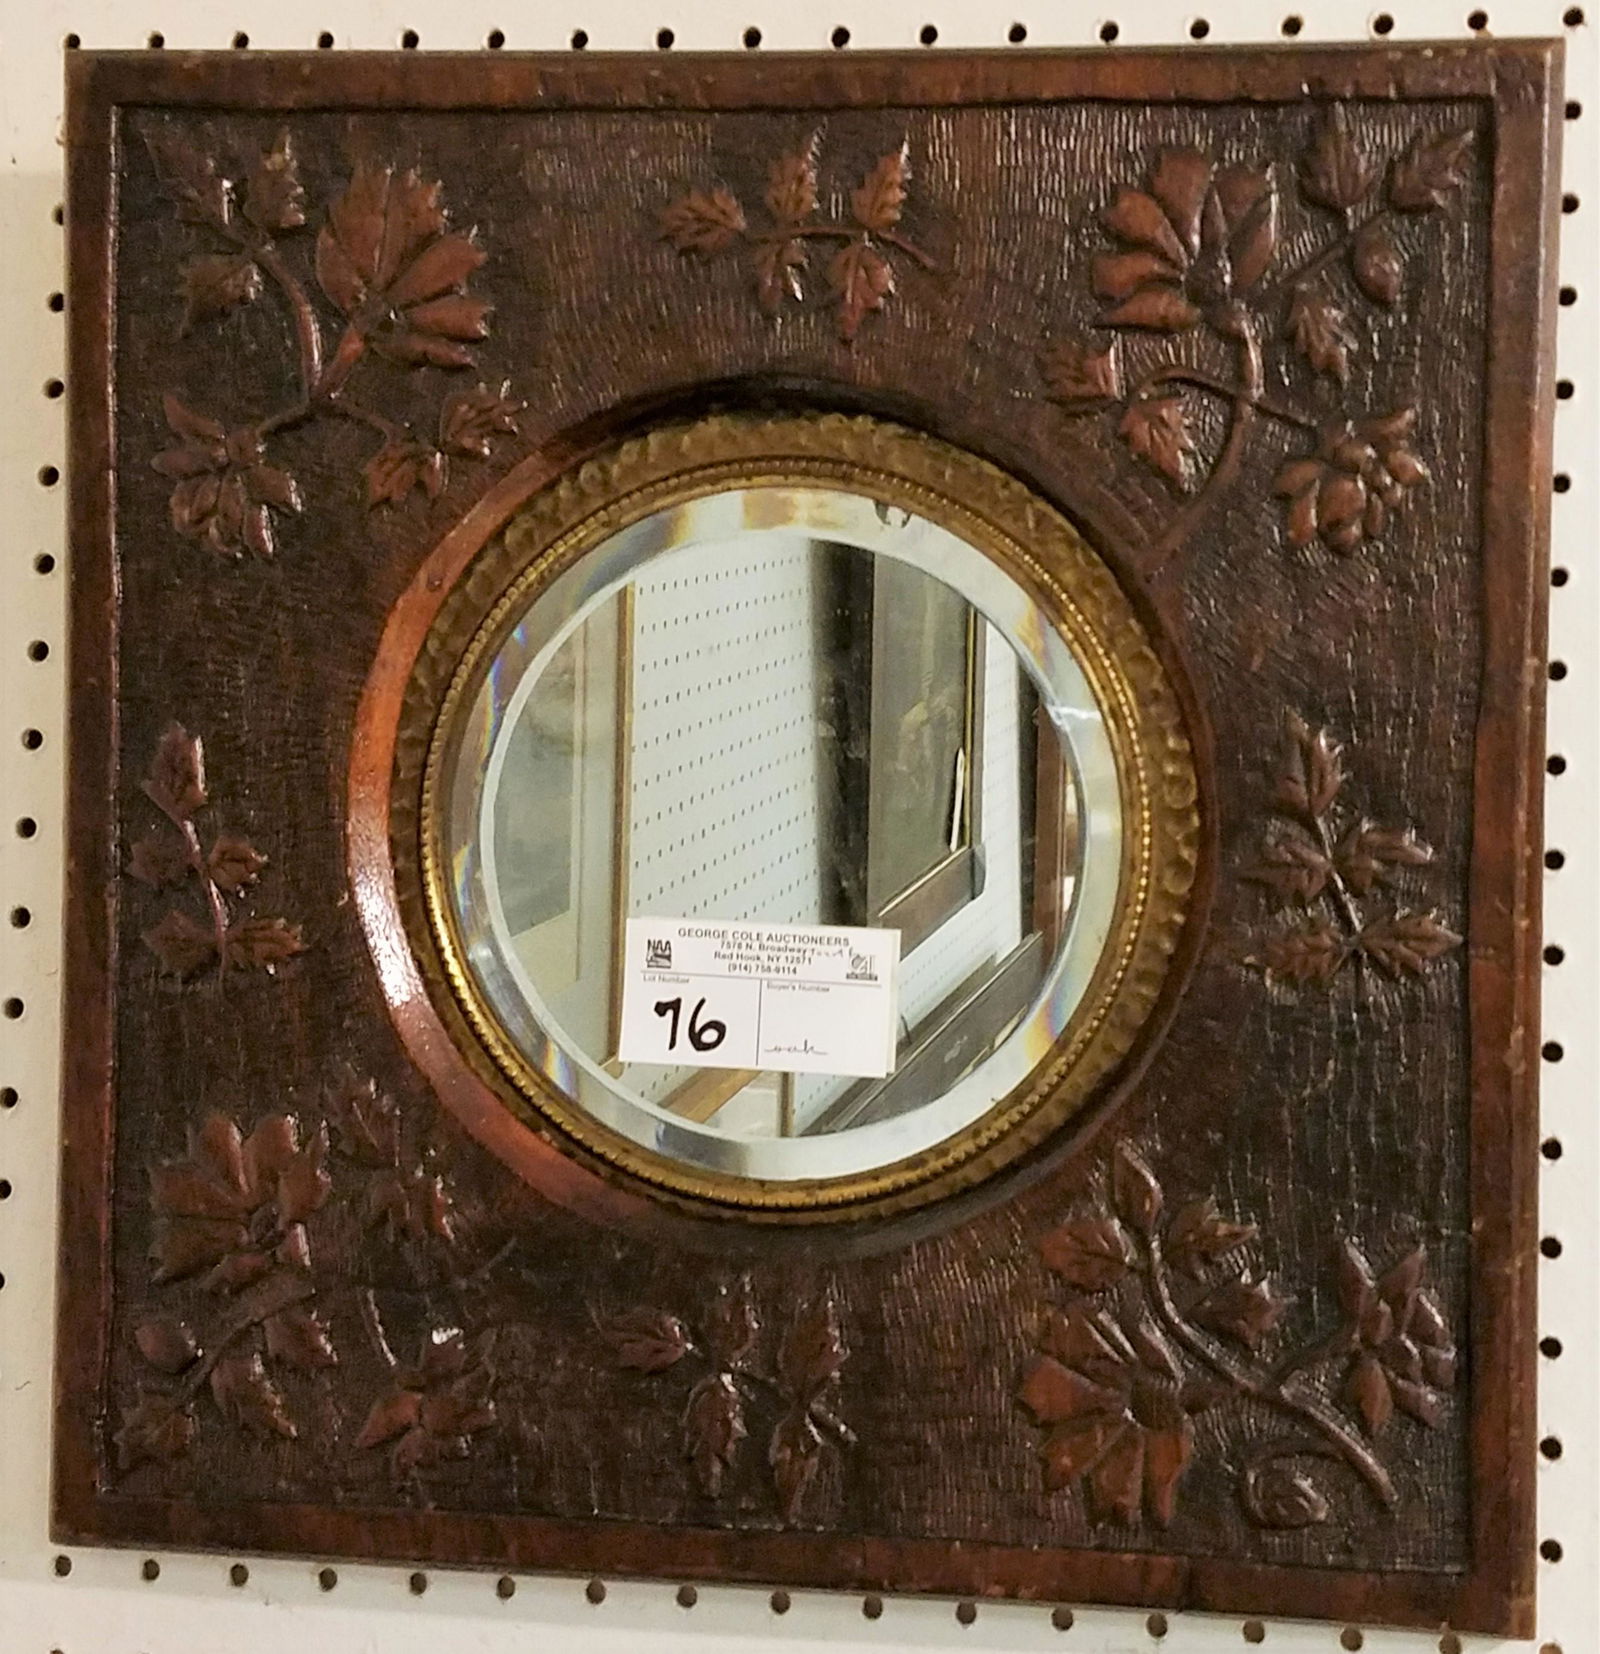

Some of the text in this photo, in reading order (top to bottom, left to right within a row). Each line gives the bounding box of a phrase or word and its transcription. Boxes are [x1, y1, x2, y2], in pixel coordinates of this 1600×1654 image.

[678, 927, 849, 946] GEORGE COLE AUCTIONEERS
[759, 943, 806, 955] Broadway
[714, 951, 733, 960] Red
[767, 954, 781, 963] NY
[728, 963, 752, 974] (914)
[653, 997, 727, 1052] 76
